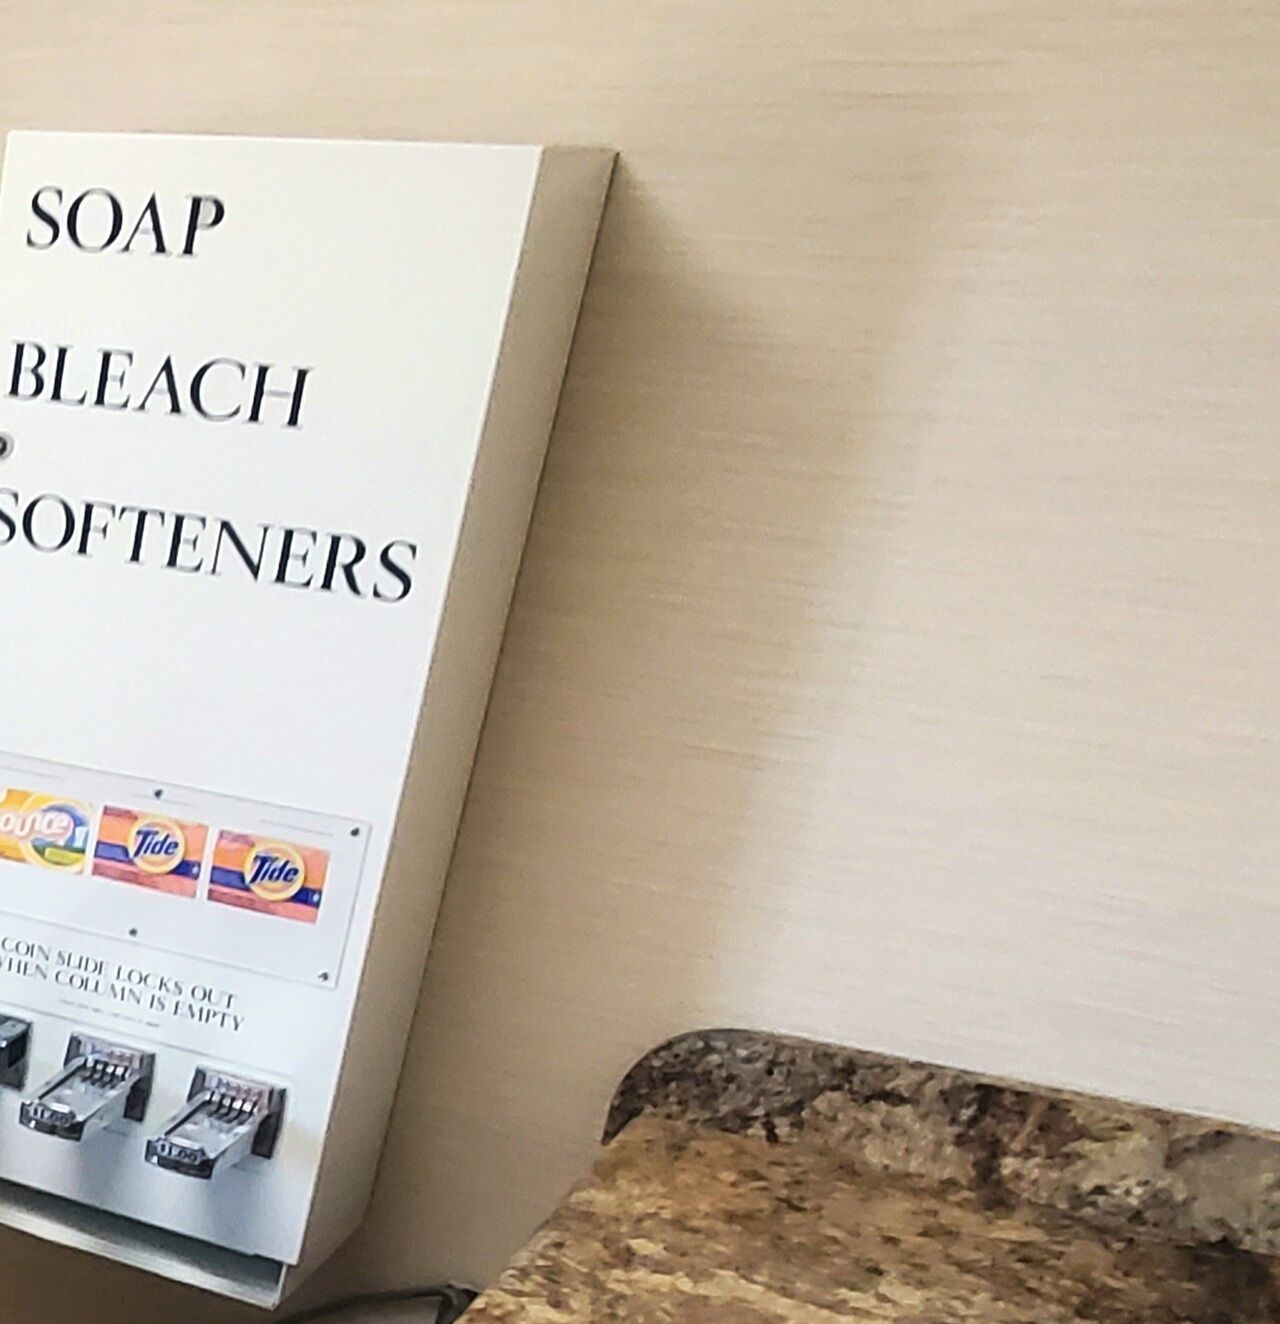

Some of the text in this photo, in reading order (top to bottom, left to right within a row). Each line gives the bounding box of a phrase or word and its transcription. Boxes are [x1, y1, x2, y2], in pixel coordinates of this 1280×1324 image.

[25, 185, 226, 258] SOAP
[6, 341, 313, 428] BLEACH
[132, 828, 180, 858] Tide
[247, 853, 300, 885] Tide
[1, 936, 238, 1010] COIN SLIDE LOCKS OUT
[53, 969, 142, 1006] COLUMN
[148, 993, 166, 1013] IS
[172, 999, 245, 1033] EMPTY
